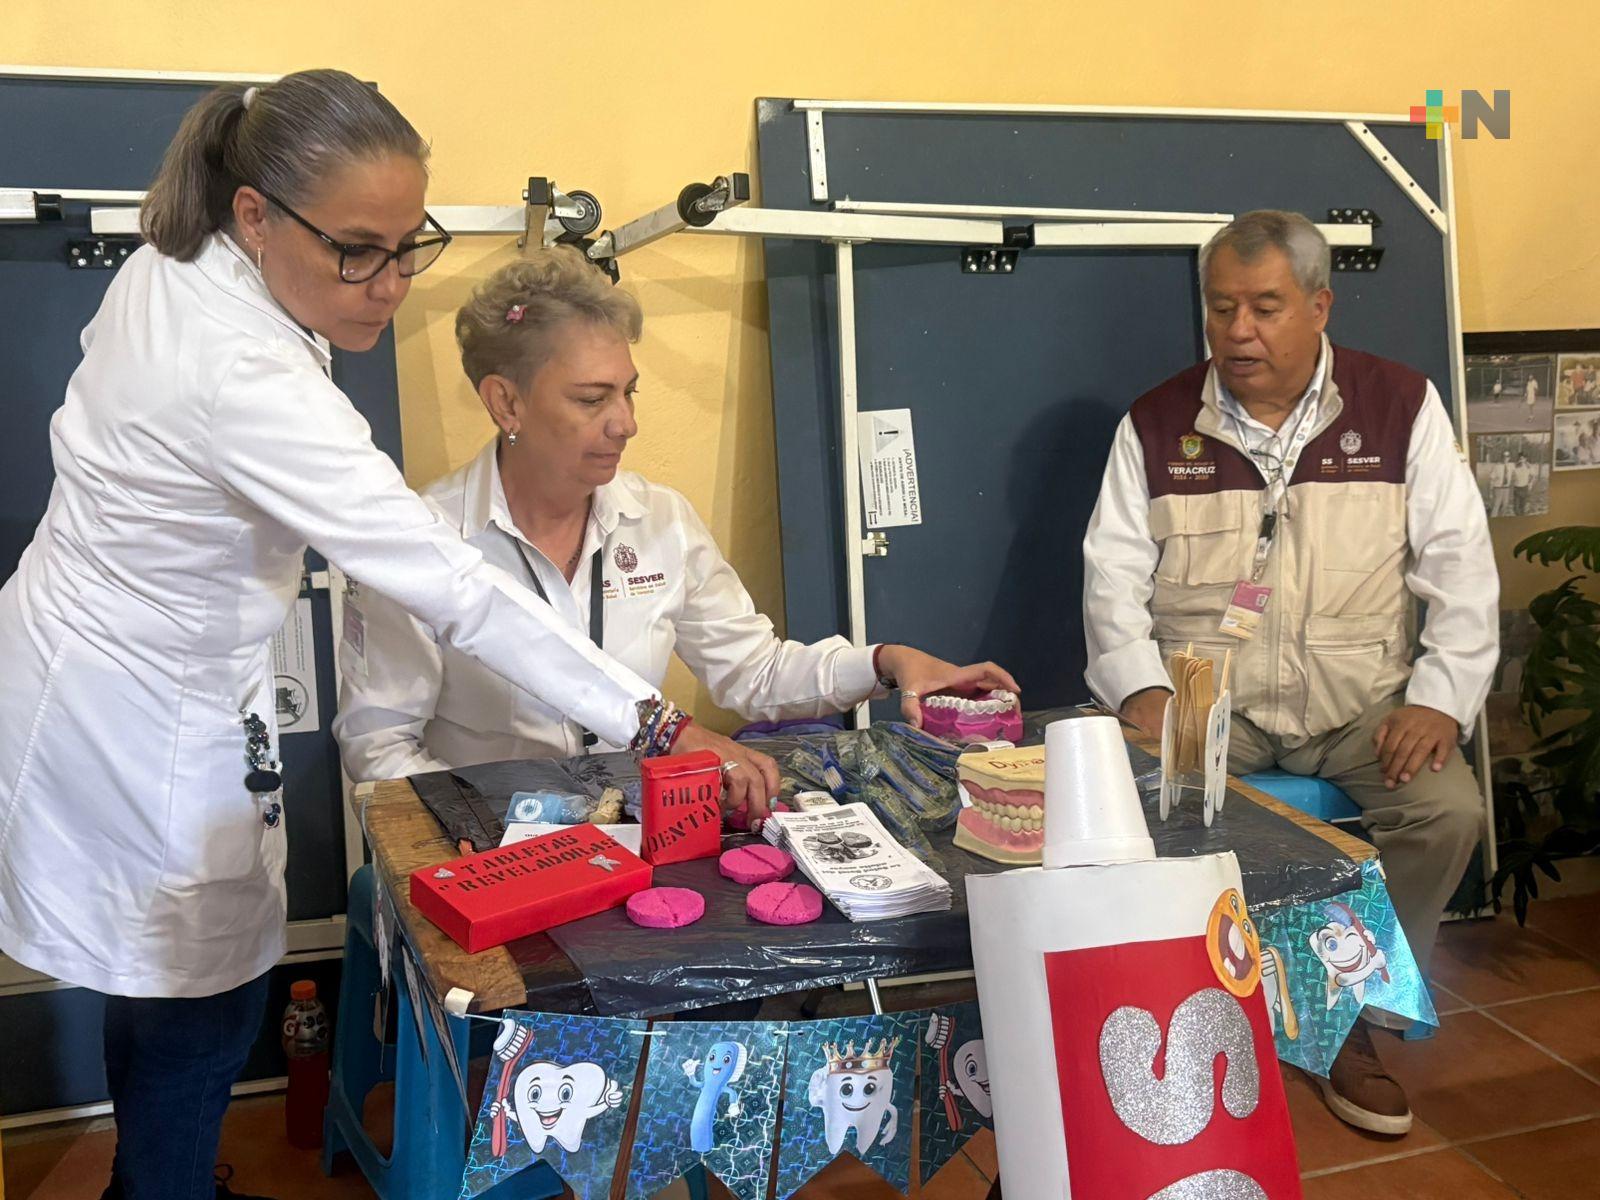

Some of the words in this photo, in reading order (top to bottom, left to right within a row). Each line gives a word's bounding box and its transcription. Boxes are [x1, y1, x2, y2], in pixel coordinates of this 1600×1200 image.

[1347, 456, 1381, 464] SESVER
[1168, 466, 1216, 474] VERACRUZ
[627, 573, 664, 585] SESVER
[662, 784, 712, 807] HILO
[460, 834, 578, 875] TABLETAS
